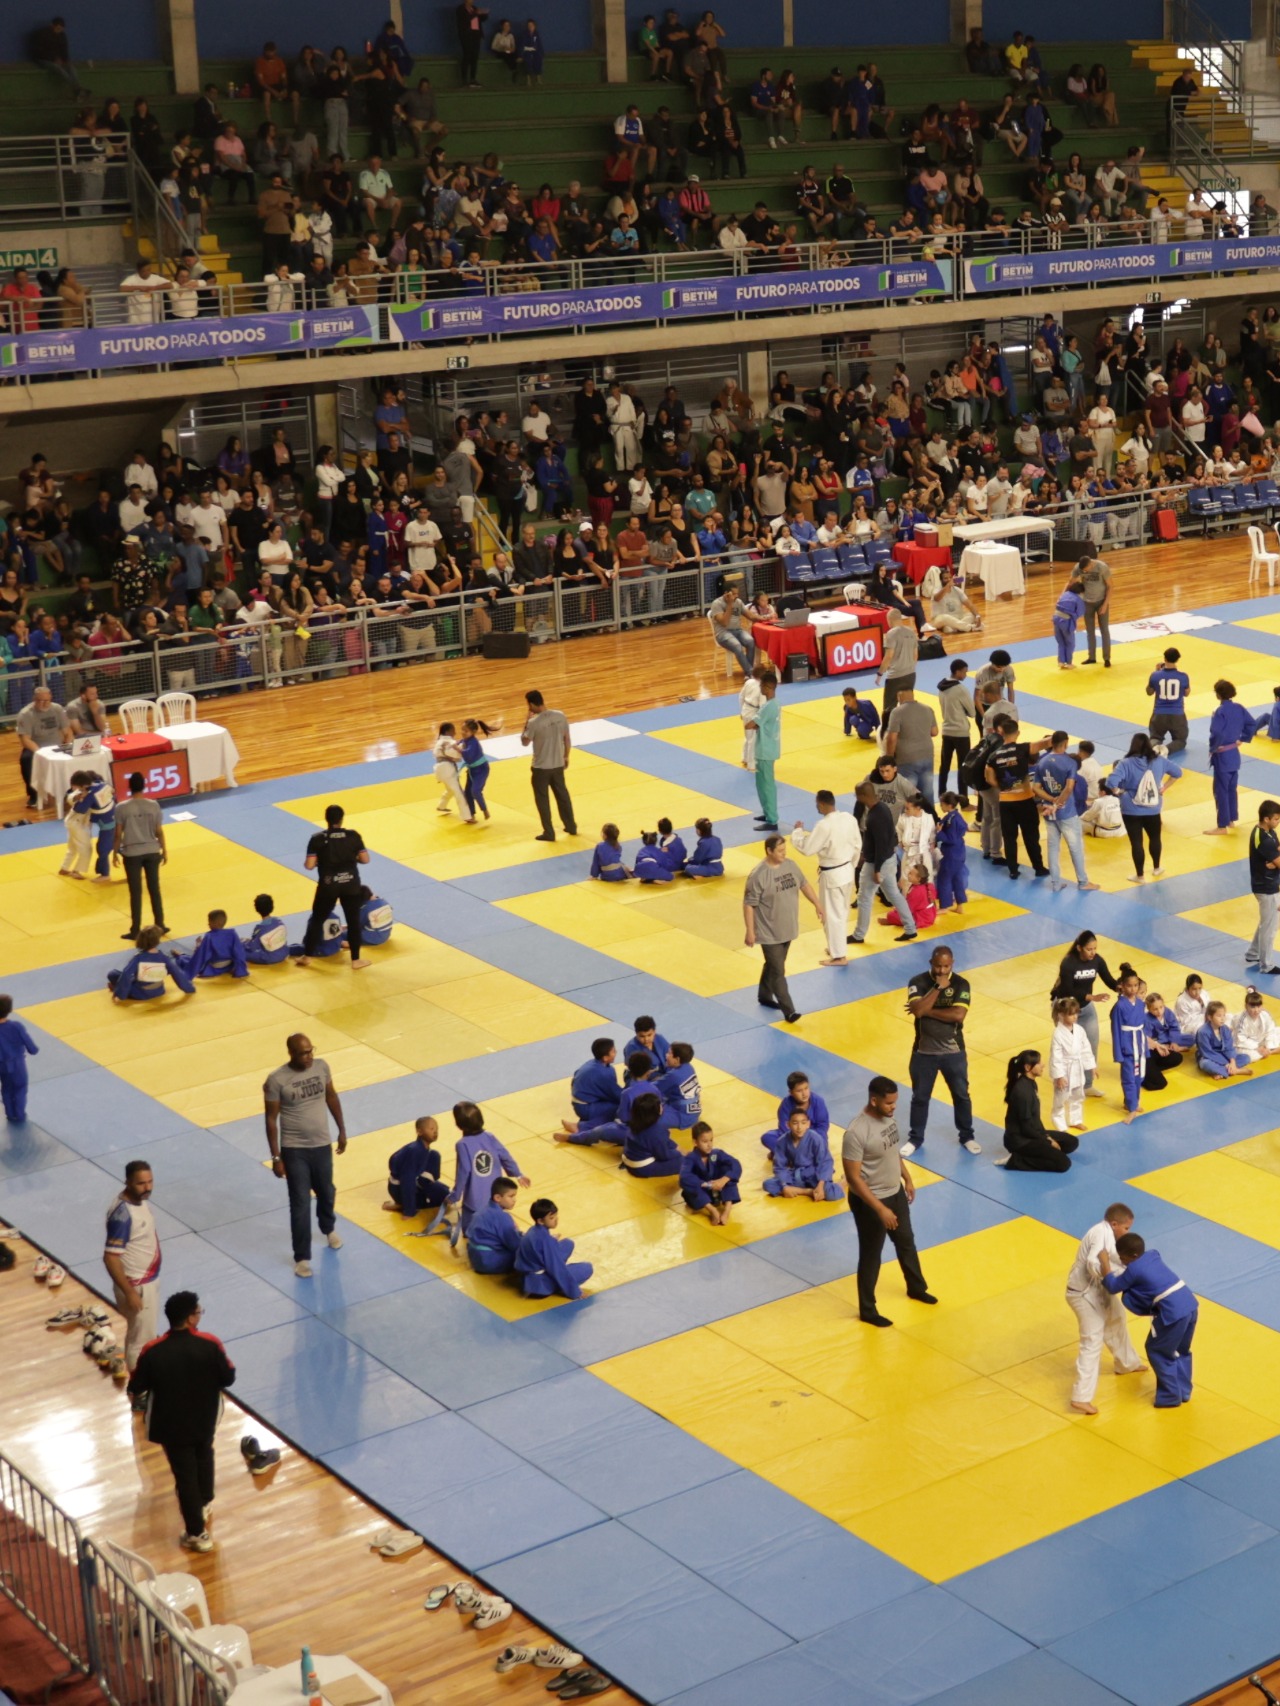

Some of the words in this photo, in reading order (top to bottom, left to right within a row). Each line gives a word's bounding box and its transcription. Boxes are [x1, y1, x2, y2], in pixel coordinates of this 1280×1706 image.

[40, 249, 56, 266] 4
[1184, 250, 1212, 262] BETIM
[896, 272, 928, 284] BETIM
[1002, 265, 1034, 278] BETIM
[682, 290, 718, 302] BETIM
[442, 310, 482, 322] BETIM
[314, 320, 354, 334] BETIM
[28, 344, 75, 358] BETIM
[834, 640, 876, 667] 0:00
[1158, 678, 1180, 700] 10
[124, 765, 180, 796] :55
[301, 1081, 324, 1098] JUDO
